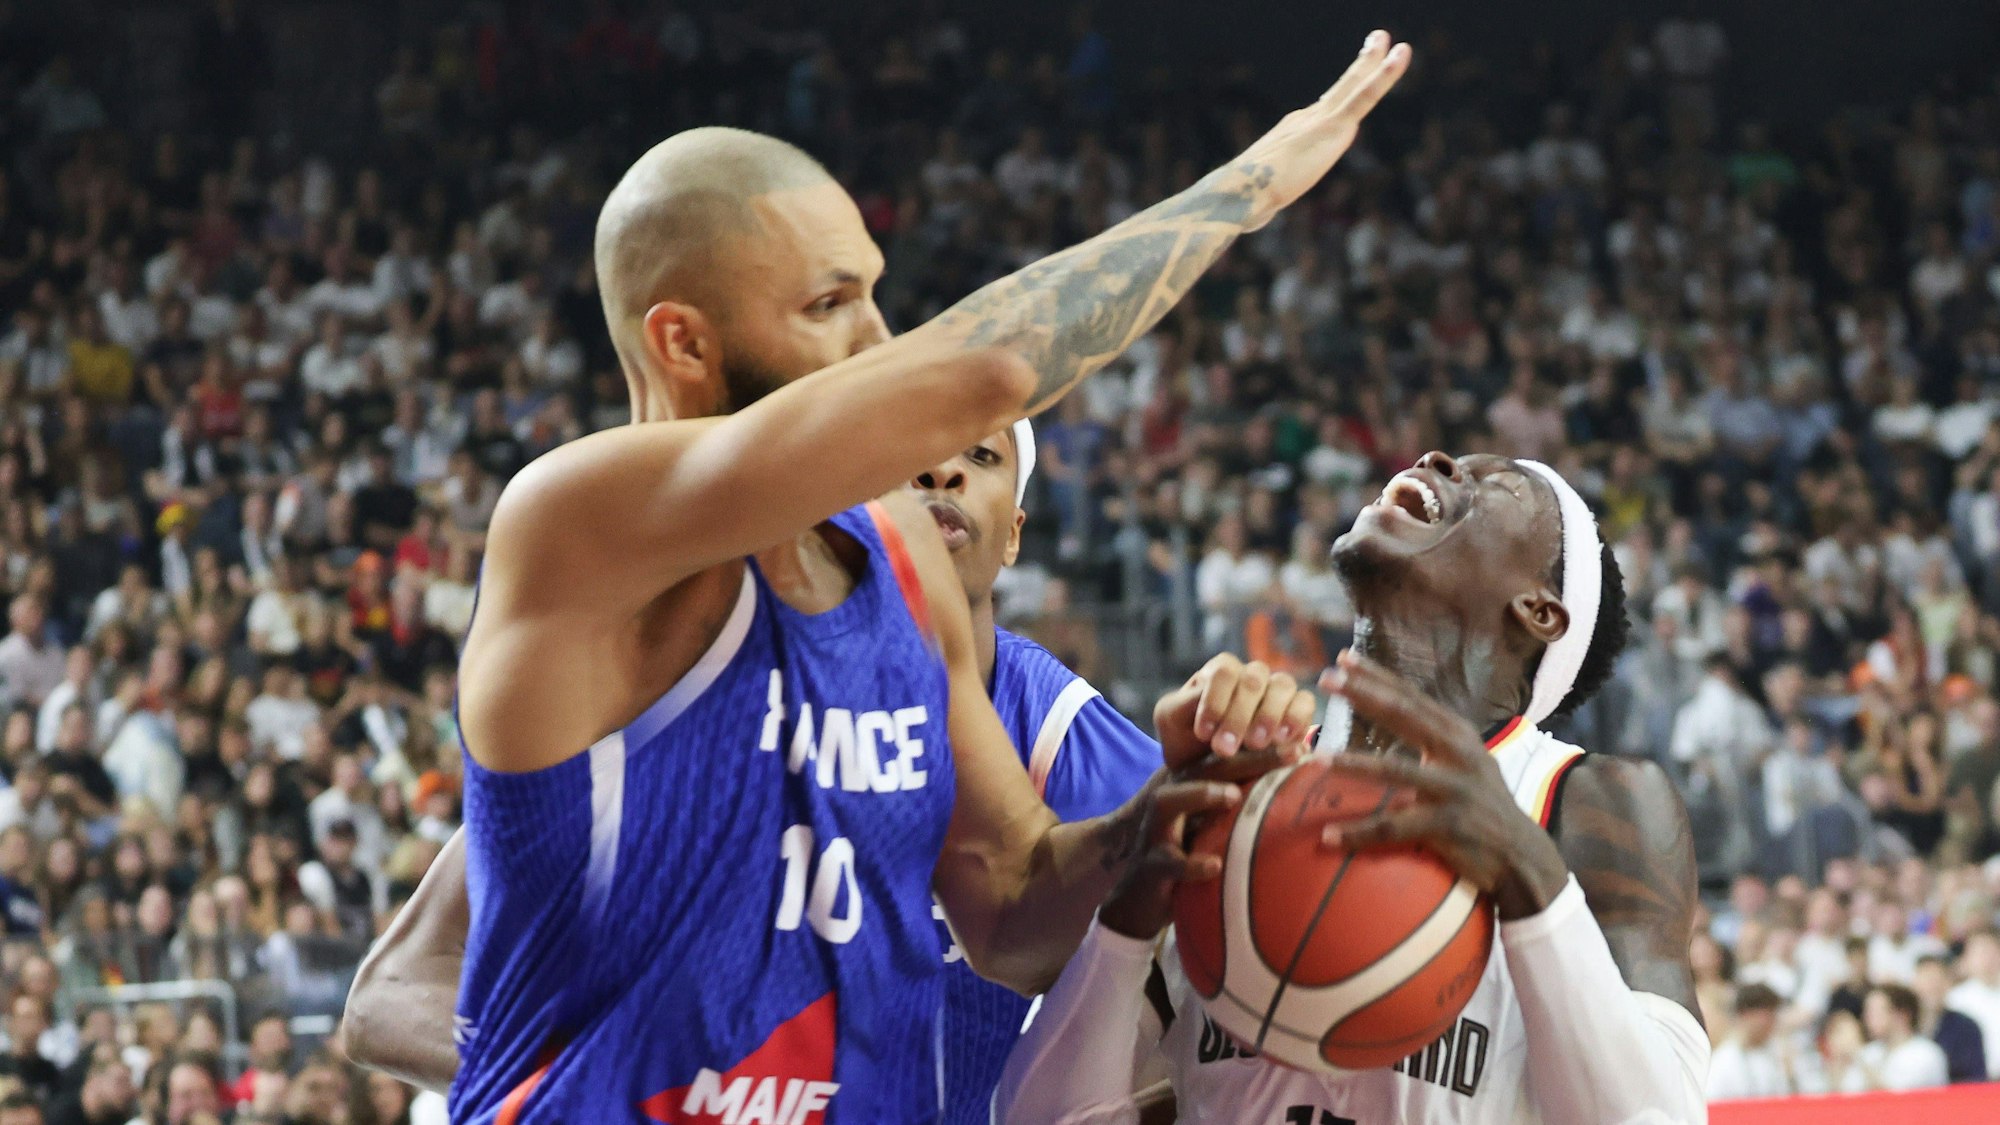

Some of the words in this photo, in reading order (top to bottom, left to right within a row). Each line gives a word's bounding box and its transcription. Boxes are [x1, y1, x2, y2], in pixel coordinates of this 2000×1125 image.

[760, 668, 927, 792] ANCE
[776, 825, 862, 943] 10
[682, 1067, 841, 1125] MAIF
